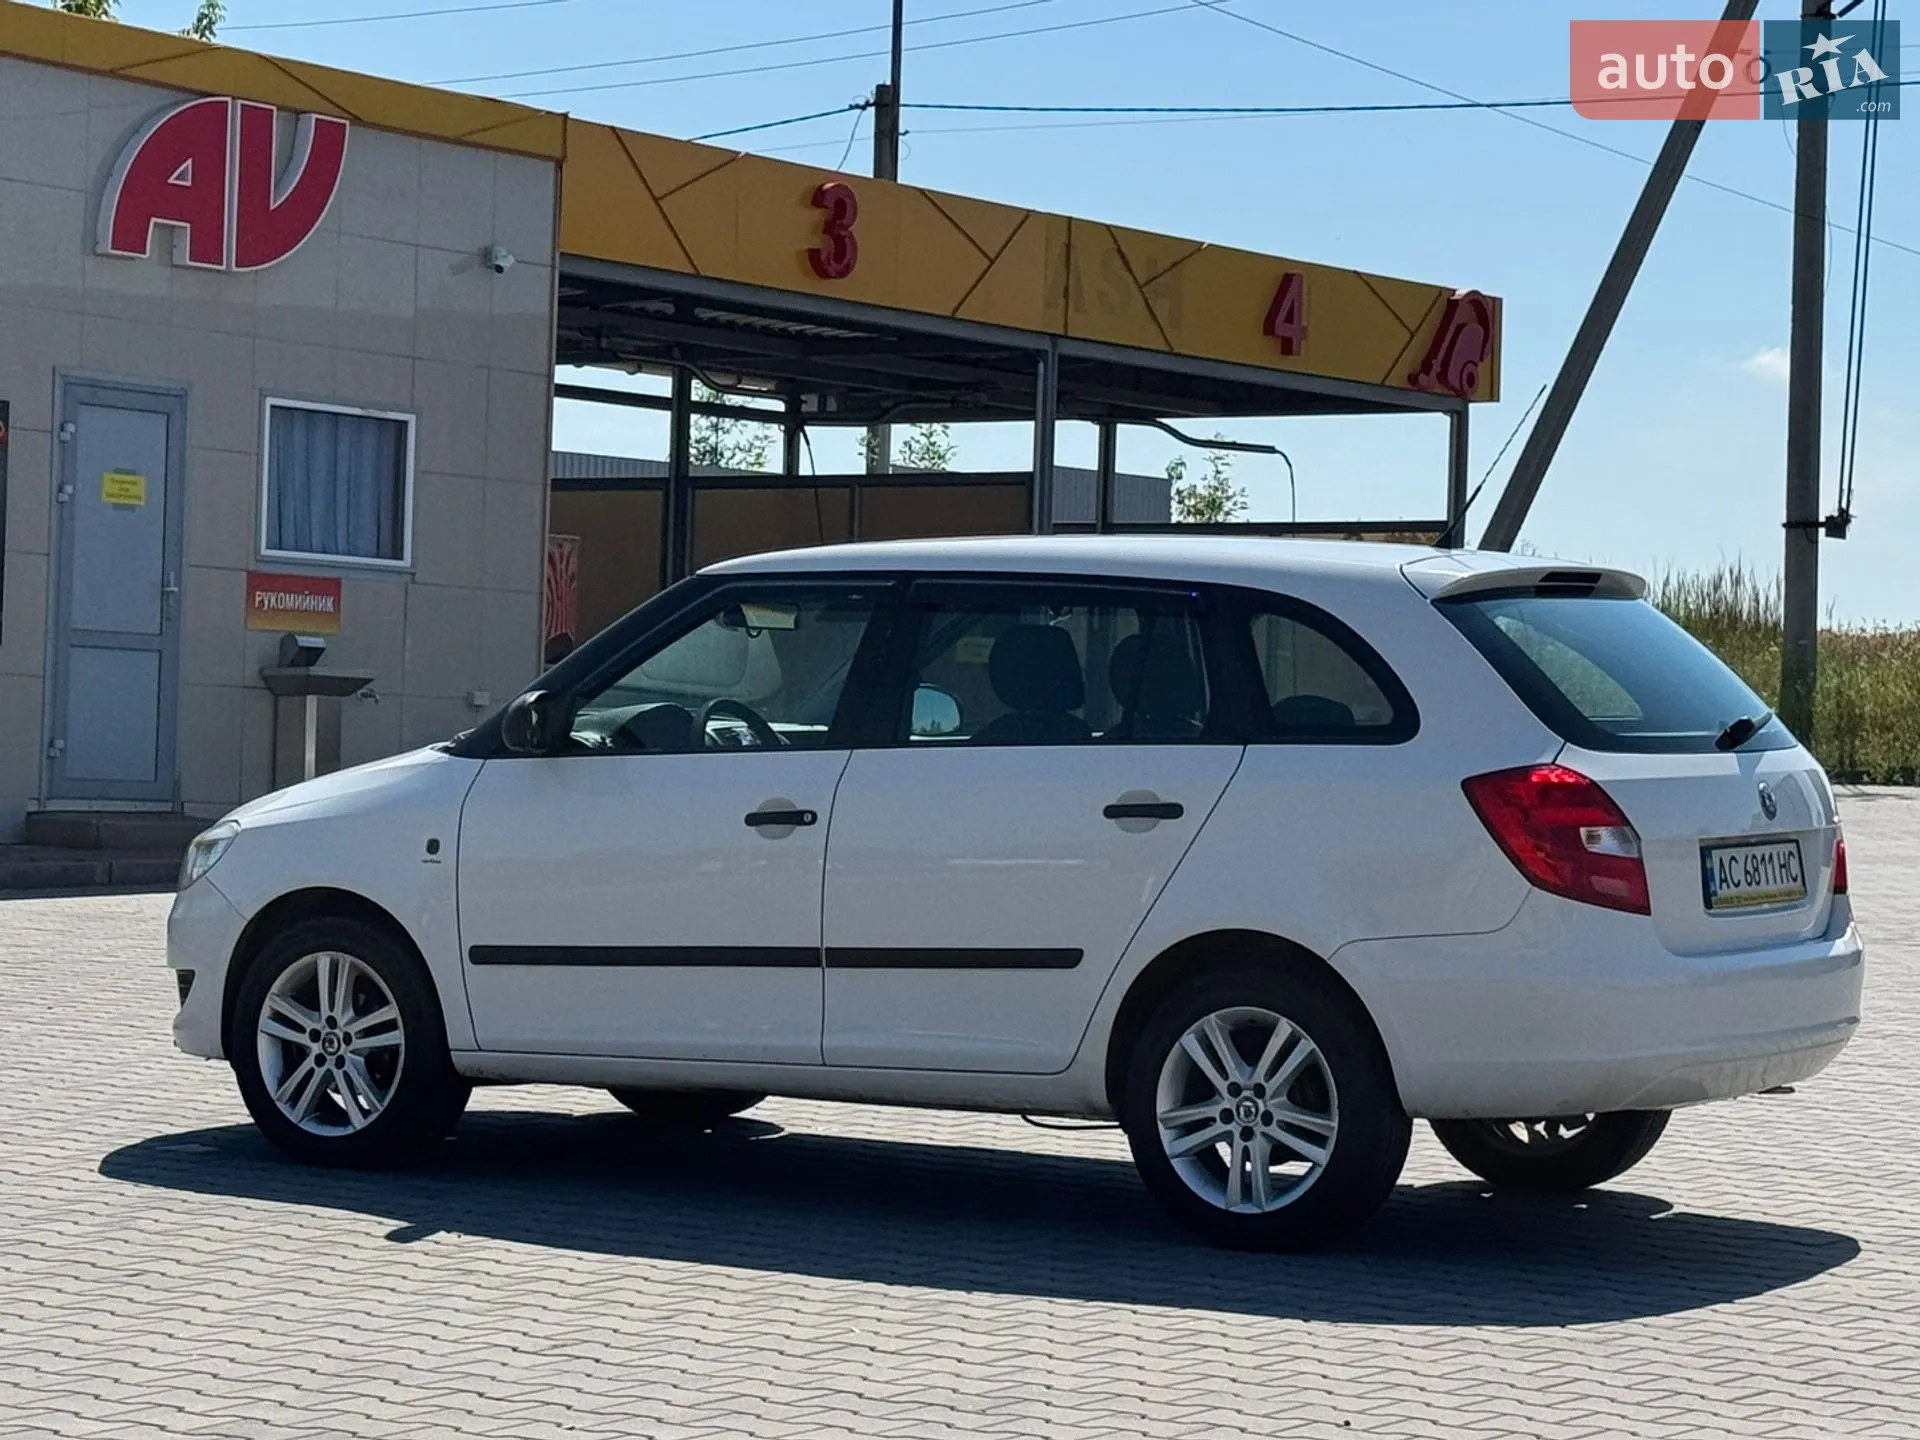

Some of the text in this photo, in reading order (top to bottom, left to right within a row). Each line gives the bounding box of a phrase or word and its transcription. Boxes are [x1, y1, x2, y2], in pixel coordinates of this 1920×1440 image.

[97, 96, 350, 272] AV
[807, 181, 858, 280] 3
[1262, 271, 1308, 356] 4
[254, 590, 335, 613] РУКОМИЙНИК
